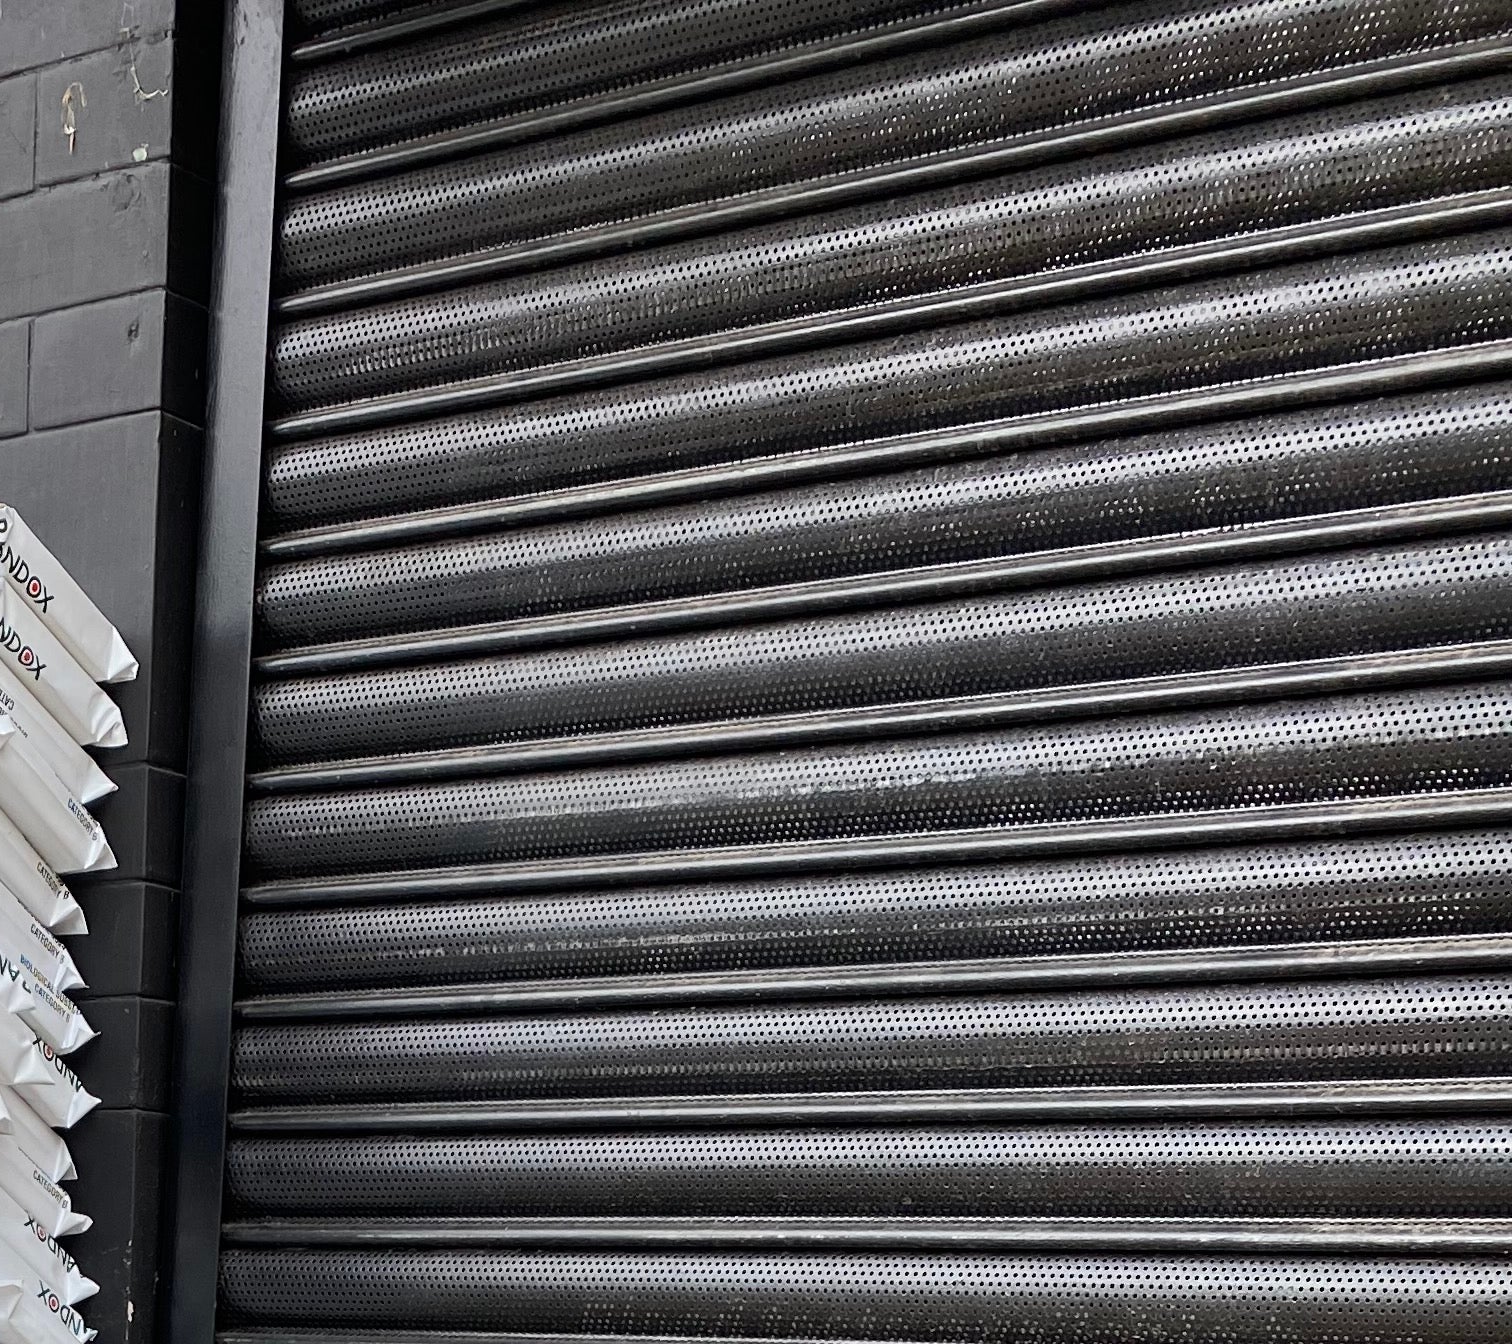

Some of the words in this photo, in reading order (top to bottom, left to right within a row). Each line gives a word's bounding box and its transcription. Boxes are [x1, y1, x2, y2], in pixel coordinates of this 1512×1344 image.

[69, 798, 94, 835] CATEGORY
[63, 891, 70, 899] B
[30, 923, 59, 959] CATEGORY
[34, 983, 65, 1016] CATEGORY
[33, 1037, 83, 1093] ANDOX
[33, 1169, 63, 1204] CATEGORY
[23, 1217, 76, 1274] ANDOX
